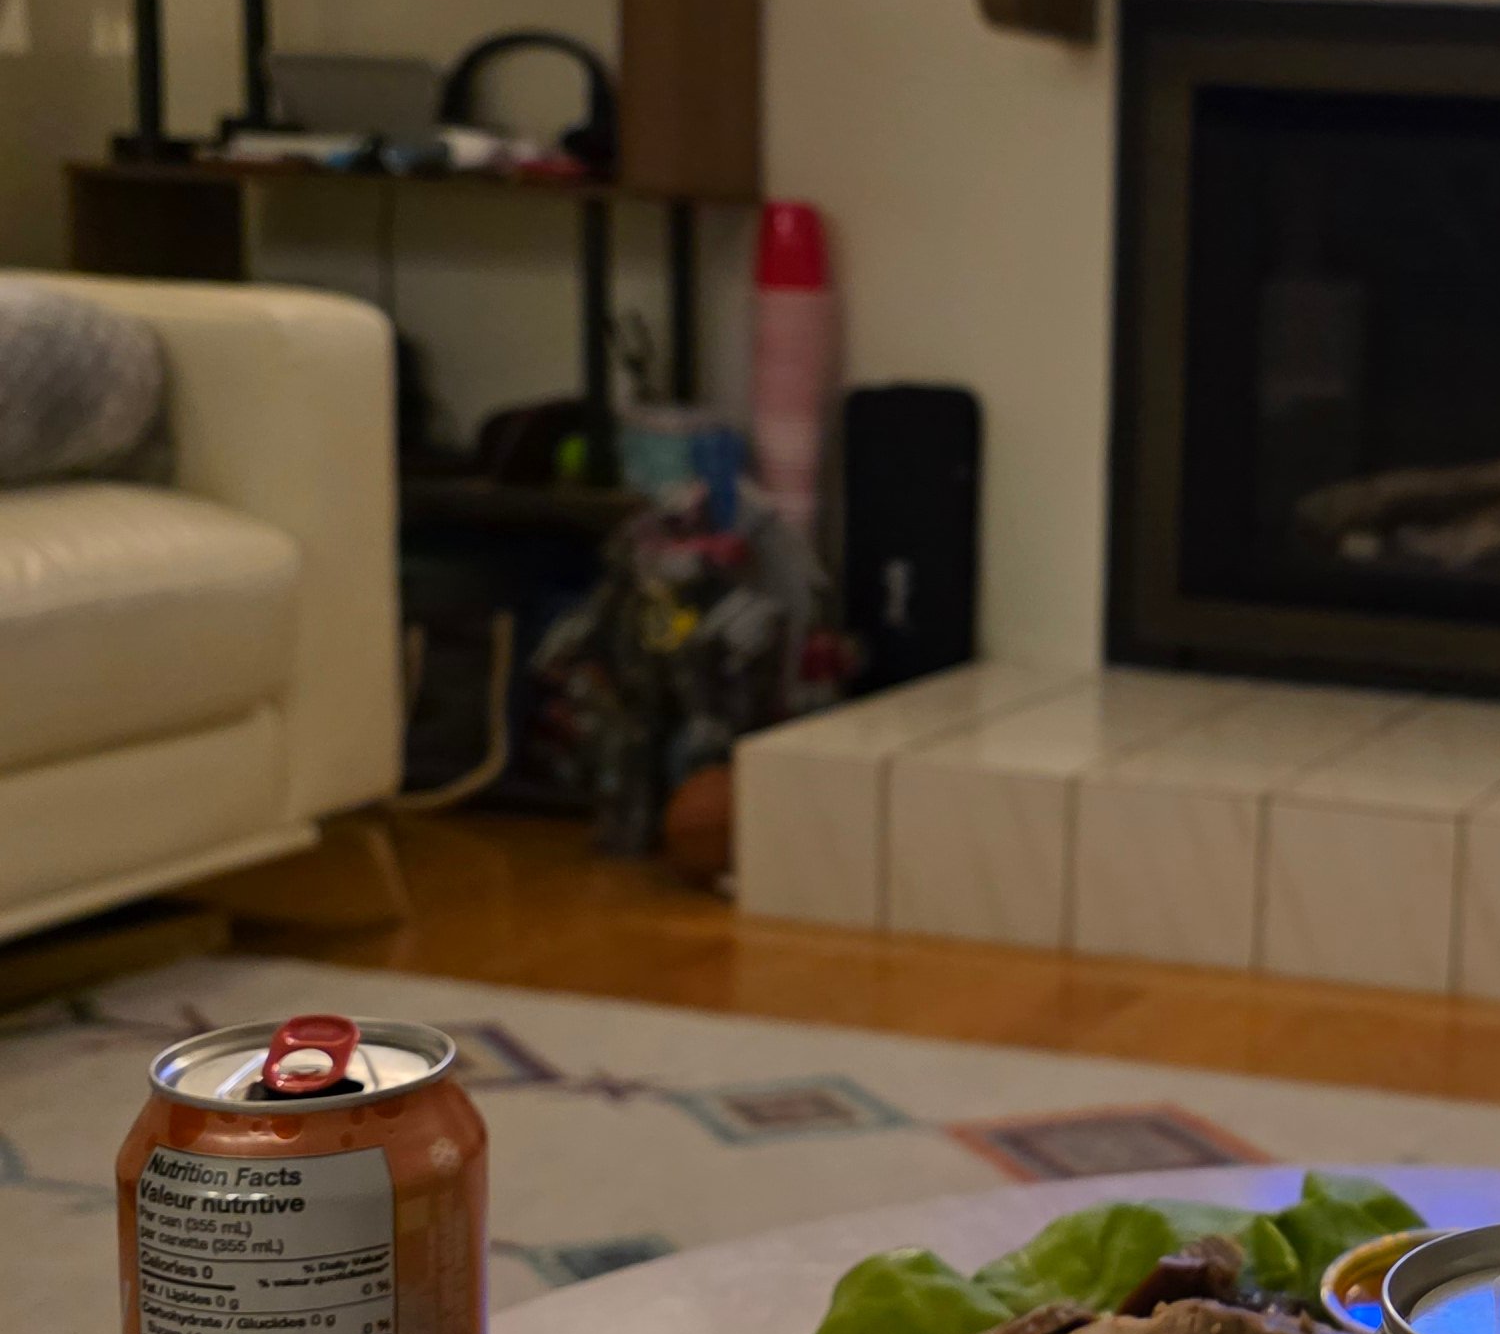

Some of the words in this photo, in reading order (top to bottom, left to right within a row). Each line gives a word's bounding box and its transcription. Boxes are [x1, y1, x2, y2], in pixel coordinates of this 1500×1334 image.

[147, 1153, 228, 1186] Nutrition
[235, 1167, 303, 1187] Facts
[139, 1178, 197, 1211] Valeur
[202, 1193, 306, 1214] nutritive
[185, 1217, 217, 1233] (355
[221, 1221, 252, 1238] mL)
[212, 1238, 247, 1253] (355
[252, 1238, 284, 1255] mL)
[215, 1295, 226, 1308] 0
[237, 1316, 305, 1330] Glucides
[310, 1314, 321, 1326] 0
